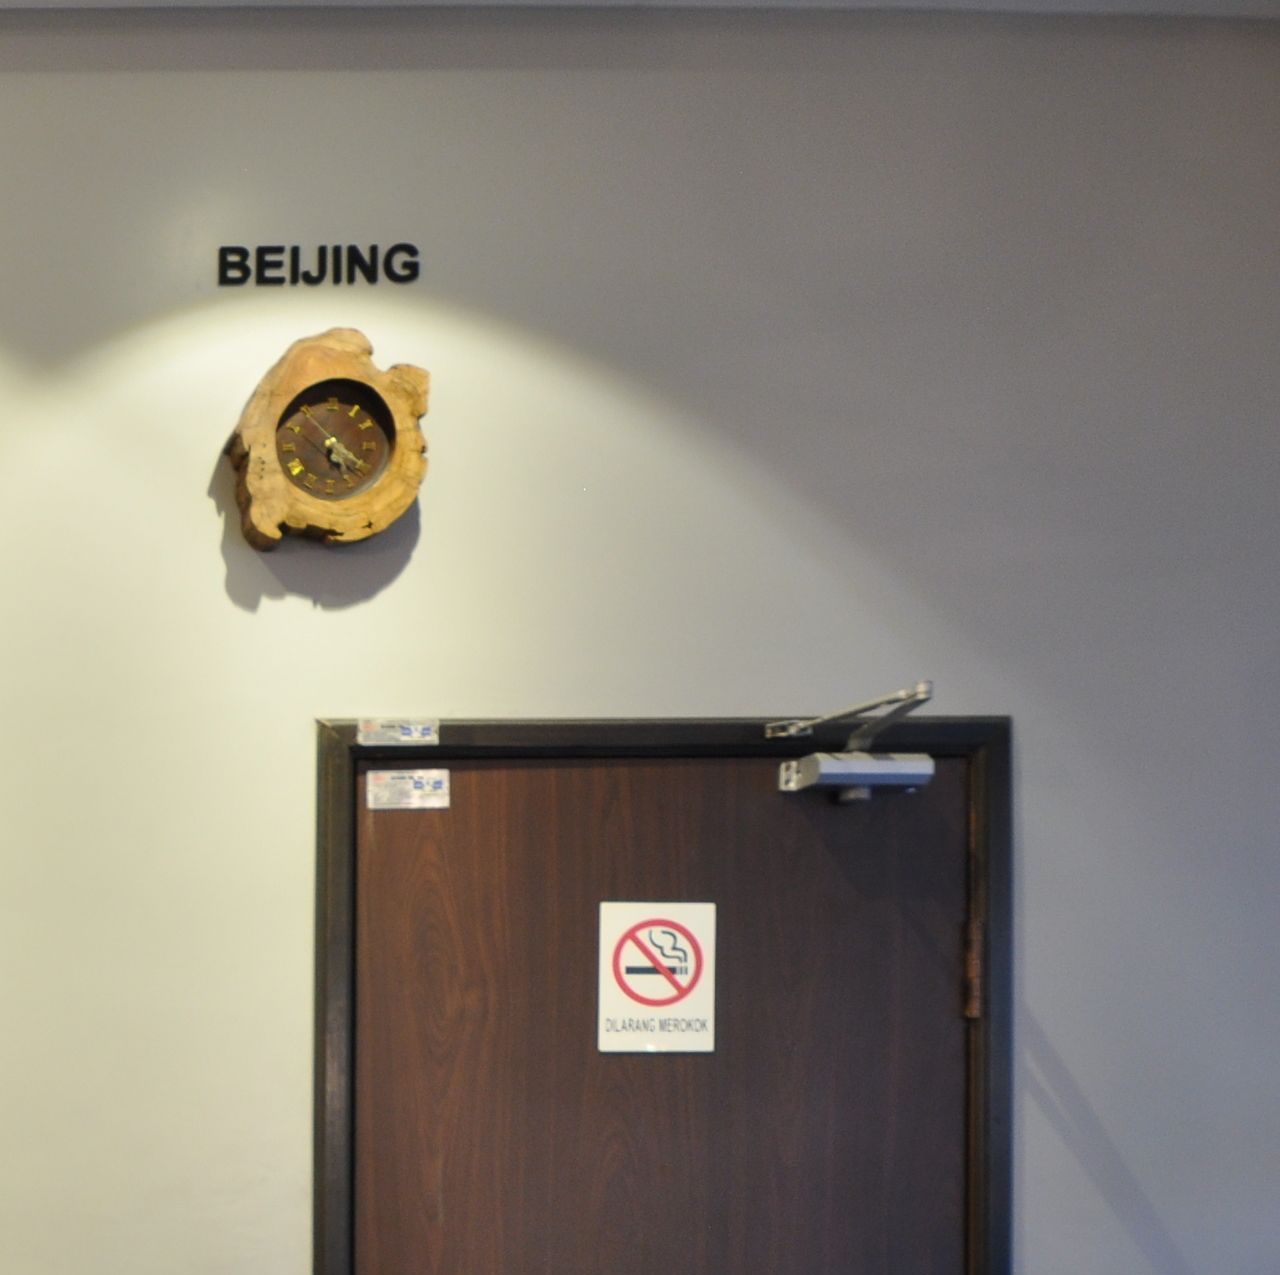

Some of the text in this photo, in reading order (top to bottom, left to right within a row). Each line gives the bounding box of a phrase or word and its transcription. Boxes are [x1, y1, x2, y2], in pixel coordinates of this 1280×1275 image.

[218, 243, 420, 286] BEIJING
[605, 1018, 708, 1032] DILARANG MEROKOK
